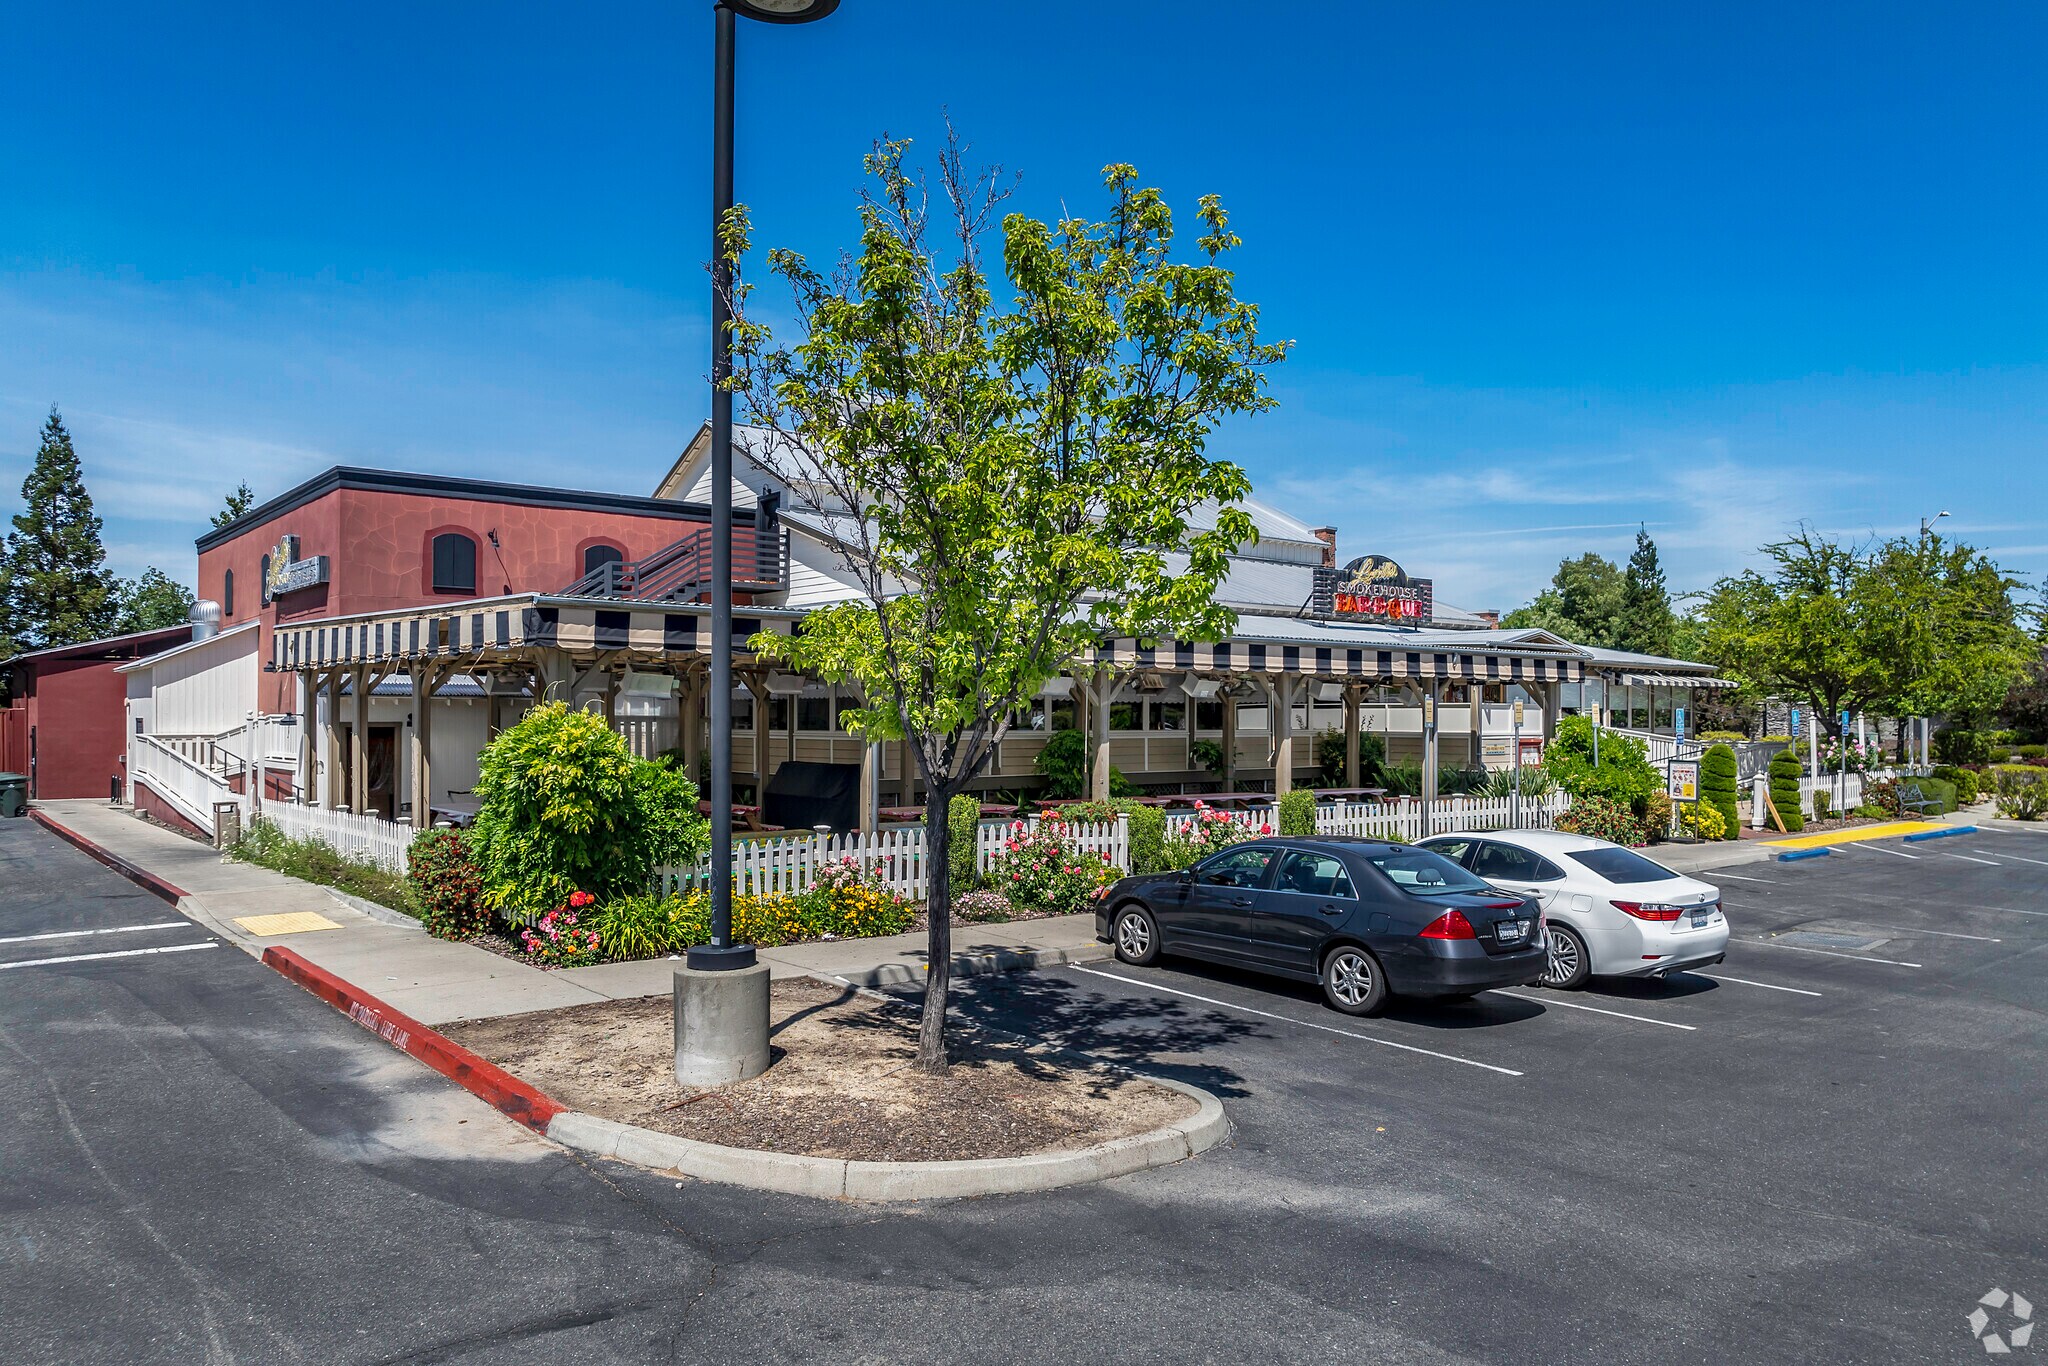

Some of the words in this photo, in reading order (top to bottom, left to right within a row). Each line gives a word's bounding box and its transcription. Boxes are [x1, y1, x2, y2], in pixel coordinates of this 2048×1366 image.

[1338, 581, 1417, 599] SMOKEHOUSE
[349, 1001, 359, 1017] NO
[357, 1006, 382, 1030] PARKING
[380, 1020, 395, 1040] FIRE
[393, 1027, 410, 1048] LANE
